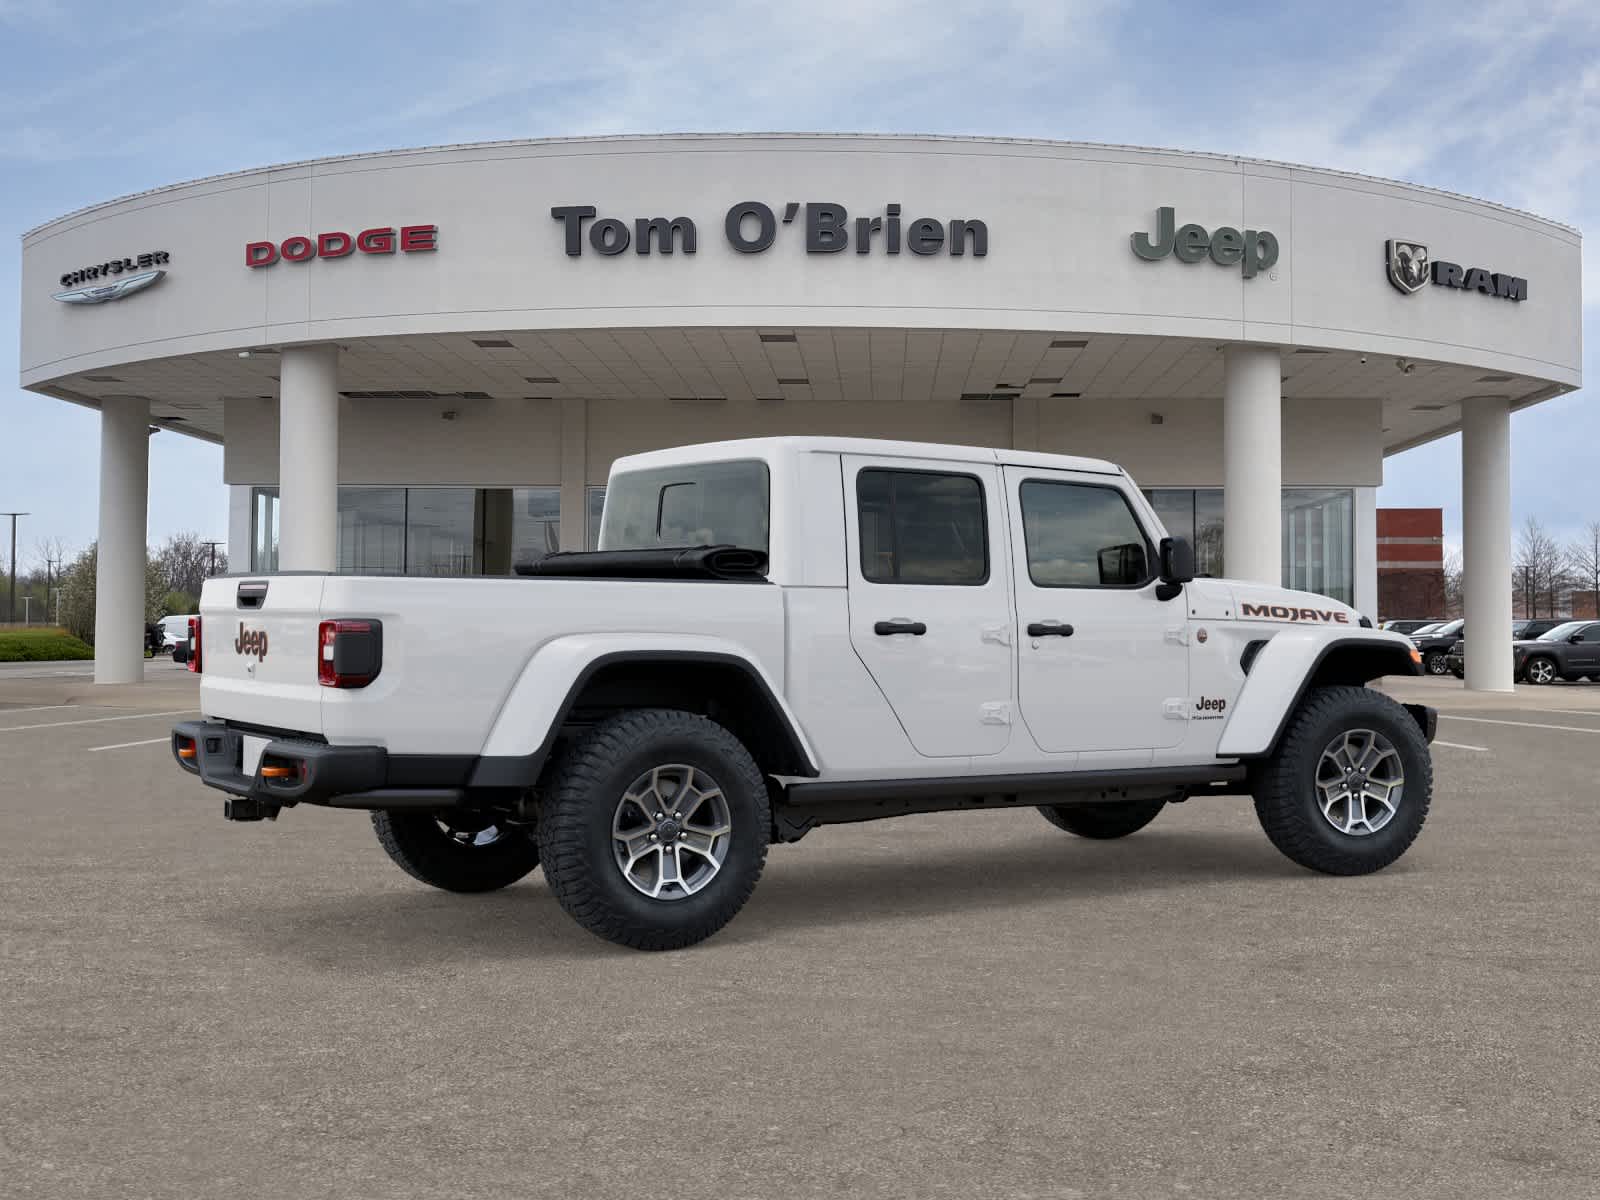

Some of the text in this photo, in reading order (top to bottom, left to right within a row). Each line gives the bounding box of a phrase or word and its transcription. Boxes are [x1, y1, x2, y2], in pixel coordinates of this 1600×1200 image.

[246, 225, 437, 268] DODGE
[551, 201, 988, 256] Tom O'Brien
[1130, 206, 1279, 279] Jeep
[60, 251, 169, 287] CHRYSLER
[1431, 260, 1527, 302] RAM
[1241, 603, 1349, 624] MOJAVE
[235, 621, 268, 663] Jeep
[1196, 695, 1226, 712] Jeep
